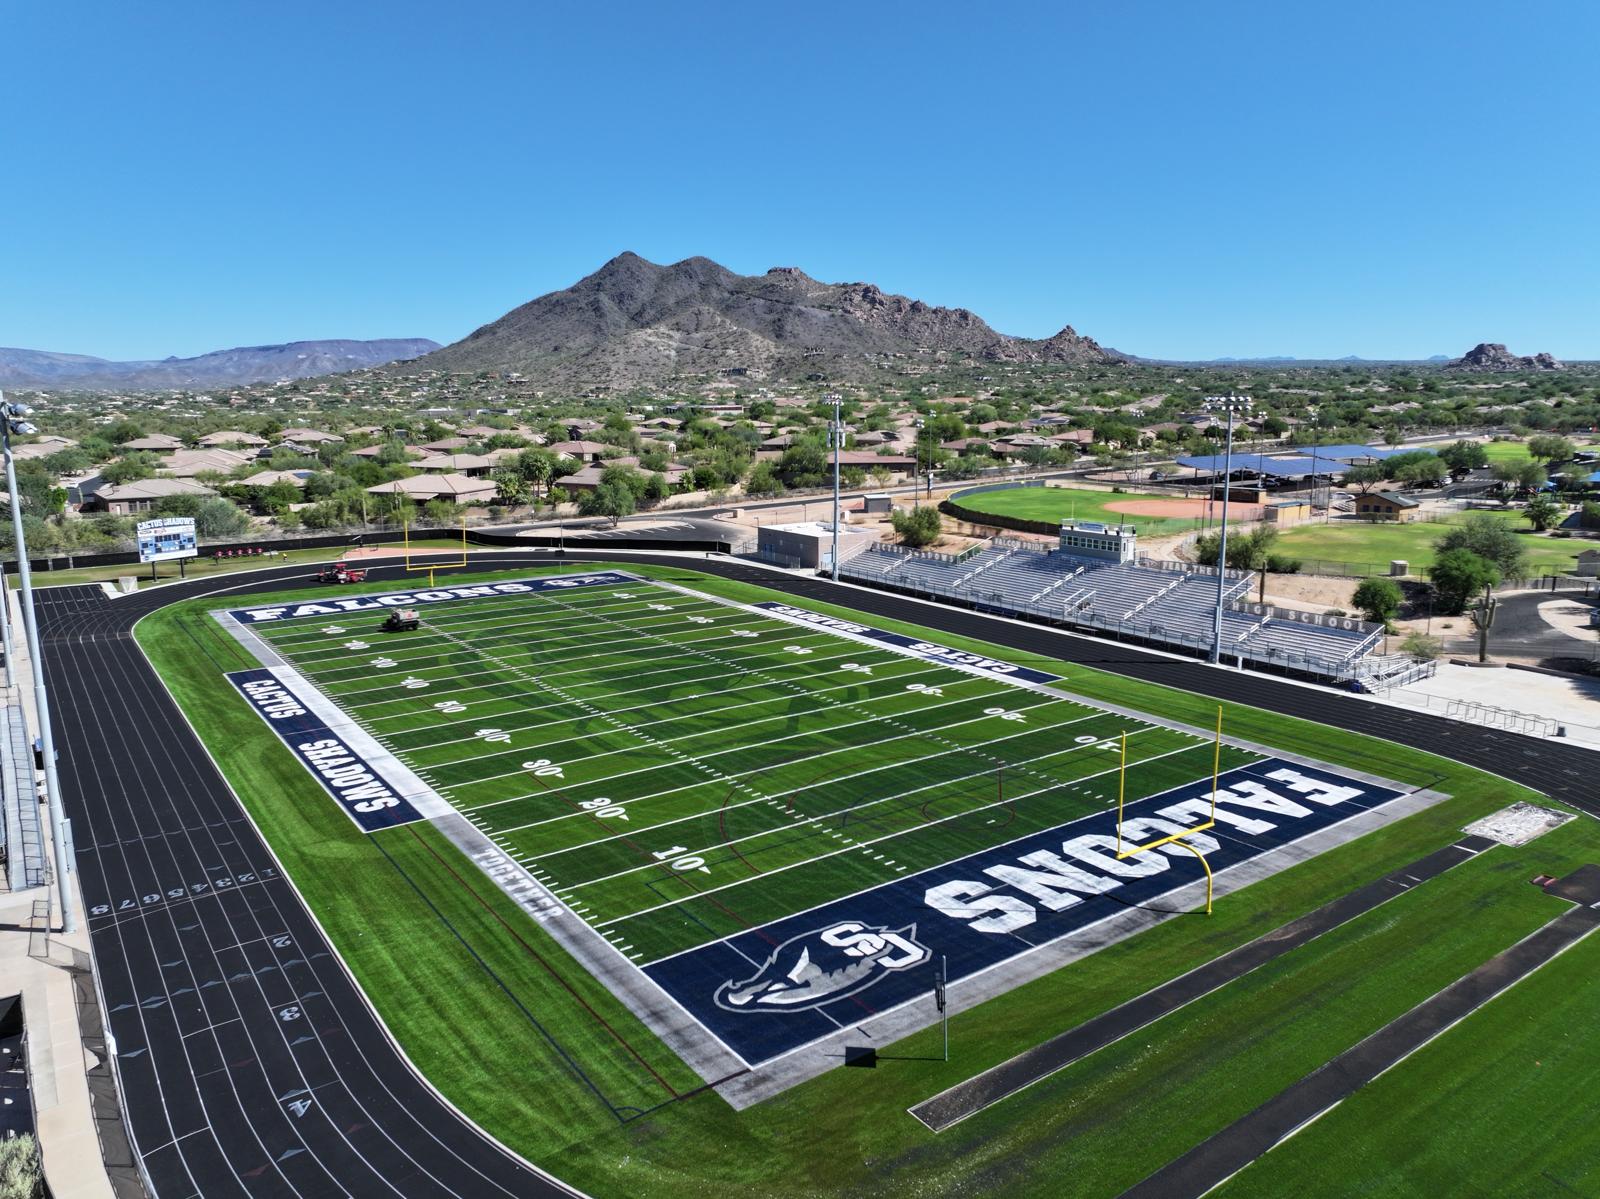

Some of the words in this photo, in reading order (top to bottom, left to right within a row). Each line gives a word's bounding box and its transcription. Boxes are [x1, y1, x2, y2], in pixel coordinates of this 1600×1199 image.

[137, 519, 163, 530] CACTUS
[163, 517, 195, 526] SHADOWS
[995, 538, 1021, 547] FALCON
[1023, 542, 1044, 551] PRIDE
[1192, 564, 1212, 575] THE
[246, 583, 533, 620] FALCONS
[769, 606, 871, 633] SHADOWS
[1232, 602, 1274, 616] HIGH
[1288, 610, 1366, 632] SCHOOL
[908, 643, 1019, 673] CACTUS
[474, 728, 511, 742] 40
[242, 679, 307, 719] CACTUS
[298, 739, 400, 813] SHADOWS
[1074, 735, 1121, 750] 10
[522, 759, 562, 776] 30
[578, 797, 626, 818] 20
[652, 846, 705, 870] 10
[924, 768, 1366, 934] FALCONS
[238, 872, 255, 882] 2
[262, 868, 277, 877] 1
[191, 883, 208, 892] 4
[215, 878, 232, 887] 3
[472, 847, 564, 922] TOGETHER
[143, 894, 161, 904] 6
[168, 888, 184, 898] 5
[90, 904, 111, 914] 8
[119, 900, 135, 909] 7
[273, 936, 292, 948] 2
[279, 1006, 301, 1021] 3
[287, 1099, 312, 1118] 4
